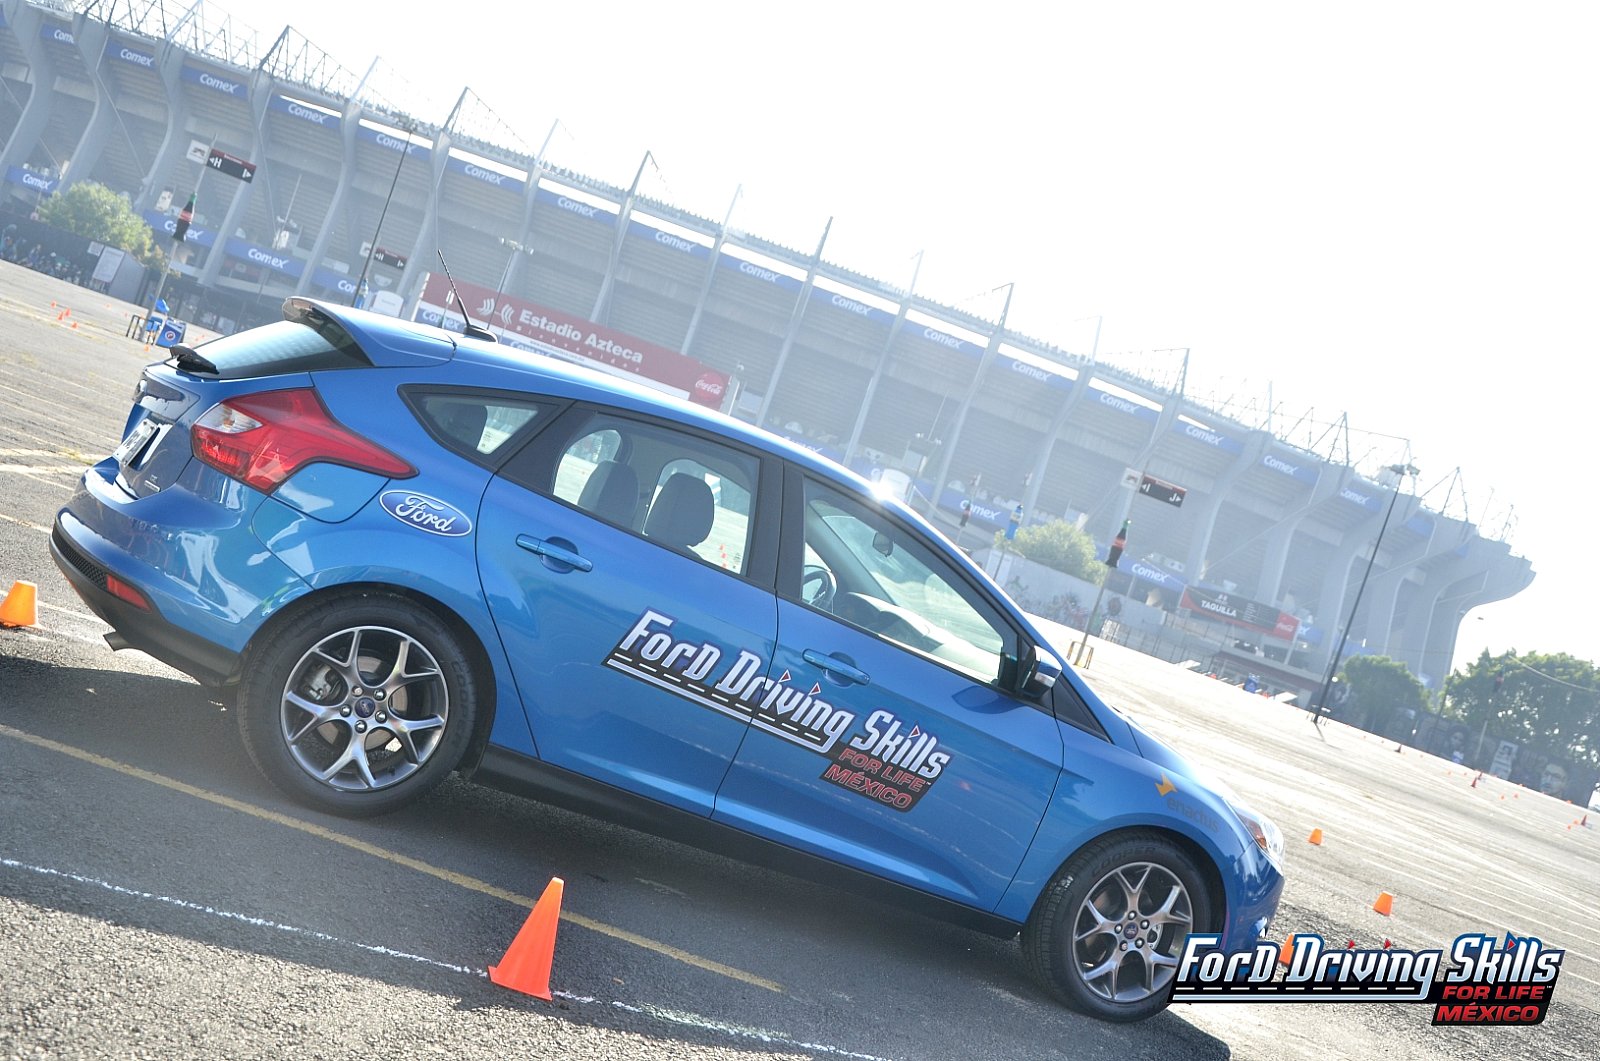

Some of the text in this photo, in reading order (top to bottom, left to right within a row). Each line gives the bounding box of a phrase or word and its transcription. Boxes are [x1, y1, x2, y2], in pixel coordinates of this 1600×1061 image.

[54, 29, 74, 44] Com
[120, 48, 154, 67] Comex
[199, 73, 239, 94] Comex
[288, 103, 329, 124] Comex
[376, 133, 417, 154] Comex
[213, 157, 222, 168] H
[22, 173, 52, 191] Comex
[465, 164, 506, 185] Comex
[557, 197, 600, 218] Comex
[164, 220, 204, 240] Coex
[655, 231, 698, 253] Comex
[247, 248, 289, 269] Comex
[739, 261, 782, 283] Comex
[831, 294, 873, 316] Comex
[519, 308, 582, 341] Estadio
[584, 332, 644, 364] Azteca
[923, 328, 965, 349] Comex
[1012, 360, 1053, 382] Comex
[1100, 393, 1141, 414] Comex
[1185, 424, 1225, 446] Comex
[1263, 455, 1299, 476] Comex
[395, 495, 457, 532] Ford
[1131, 563, 1170, 583] Comex
[1201, 600, 1237, 617] TAQUILLA
[714, 650, 855, 754] Driving
[849, 709, 951, 780] Skills
[838, 747, 928, 793] FOR LIFE
[825, 763, 913, 809] MÉXICO
